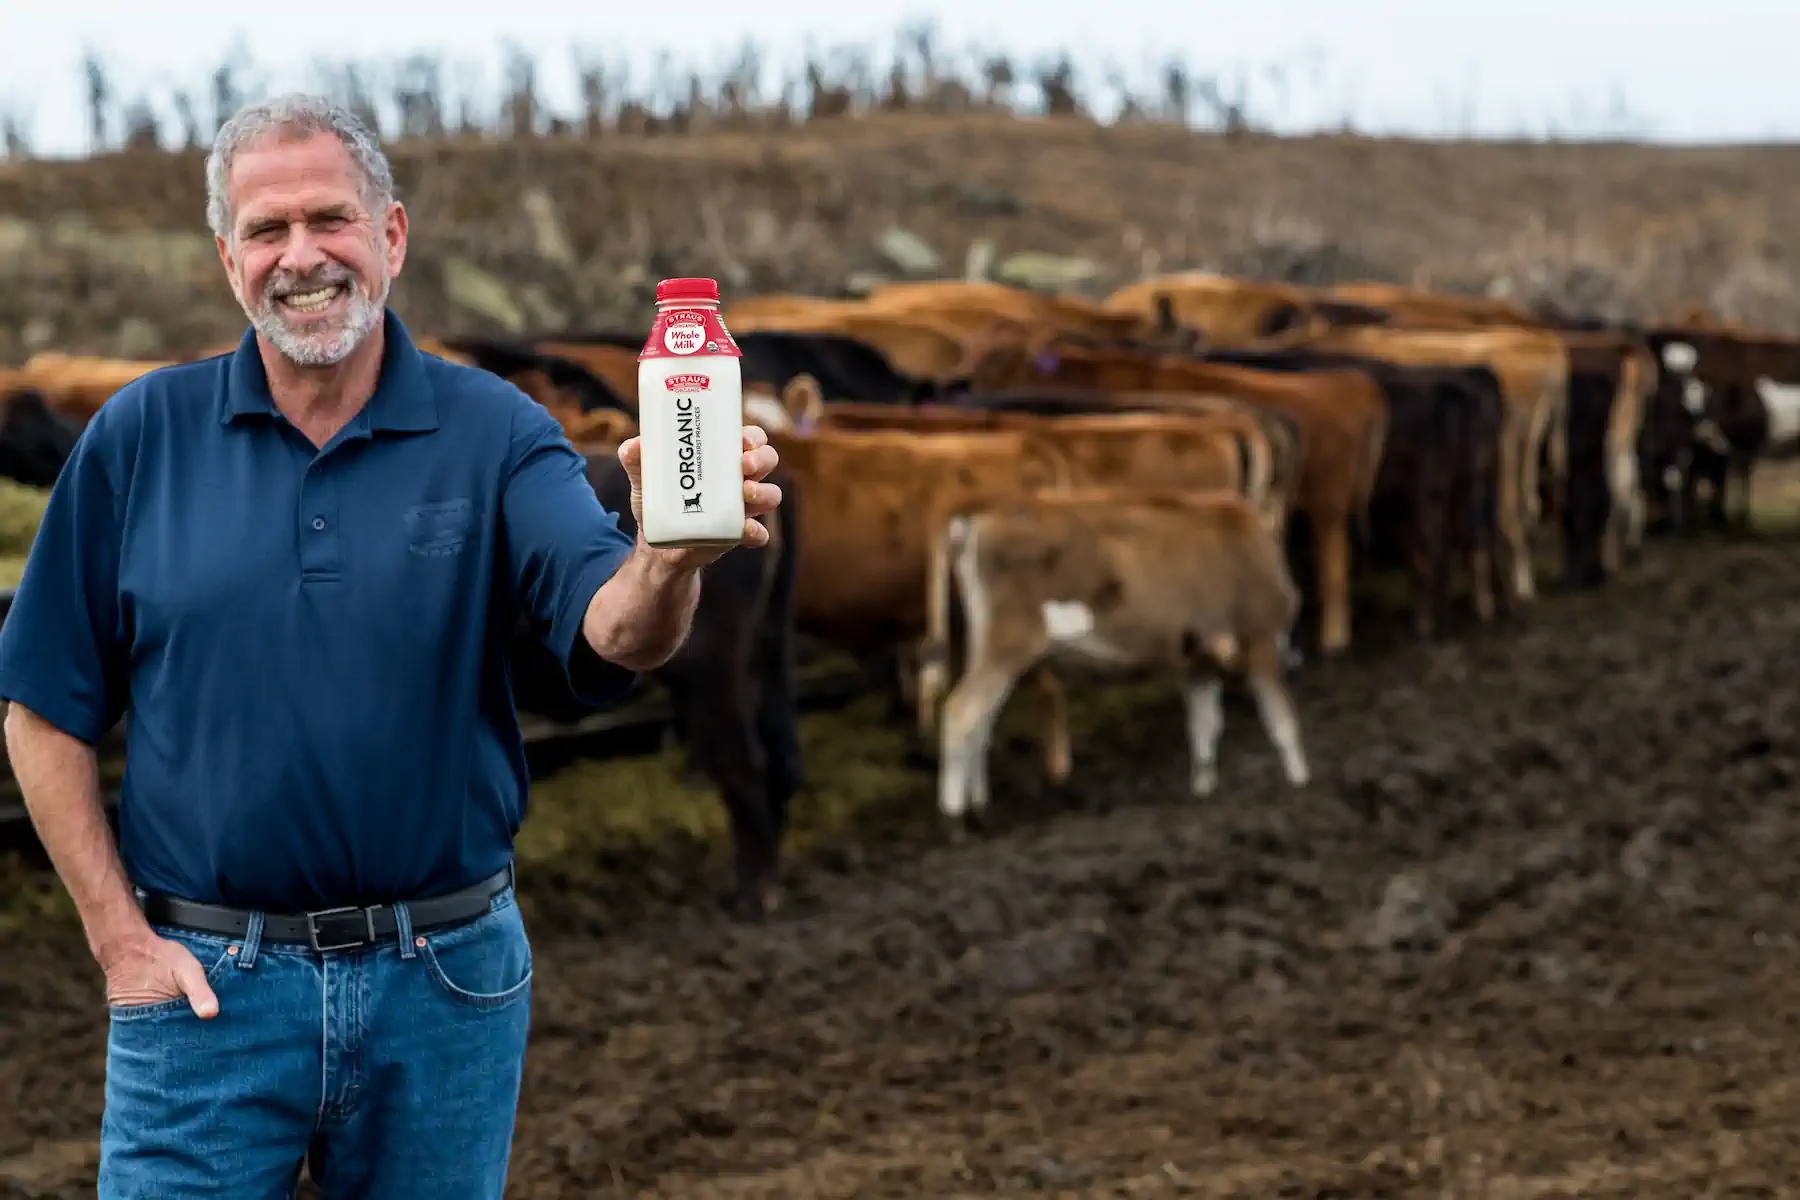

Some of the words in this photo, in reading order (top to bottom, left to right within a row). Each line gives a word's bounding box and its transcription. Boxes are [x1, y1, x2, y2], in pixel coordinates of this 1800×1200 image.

[669, 313, 703, 322] STRAUS
[671, 330, 700, 340] Whole
[673, 340, 695, 349] Milk
[668, 376, 706, 385] STRAUS
[676, 398, 695, 490] ORGANIC
